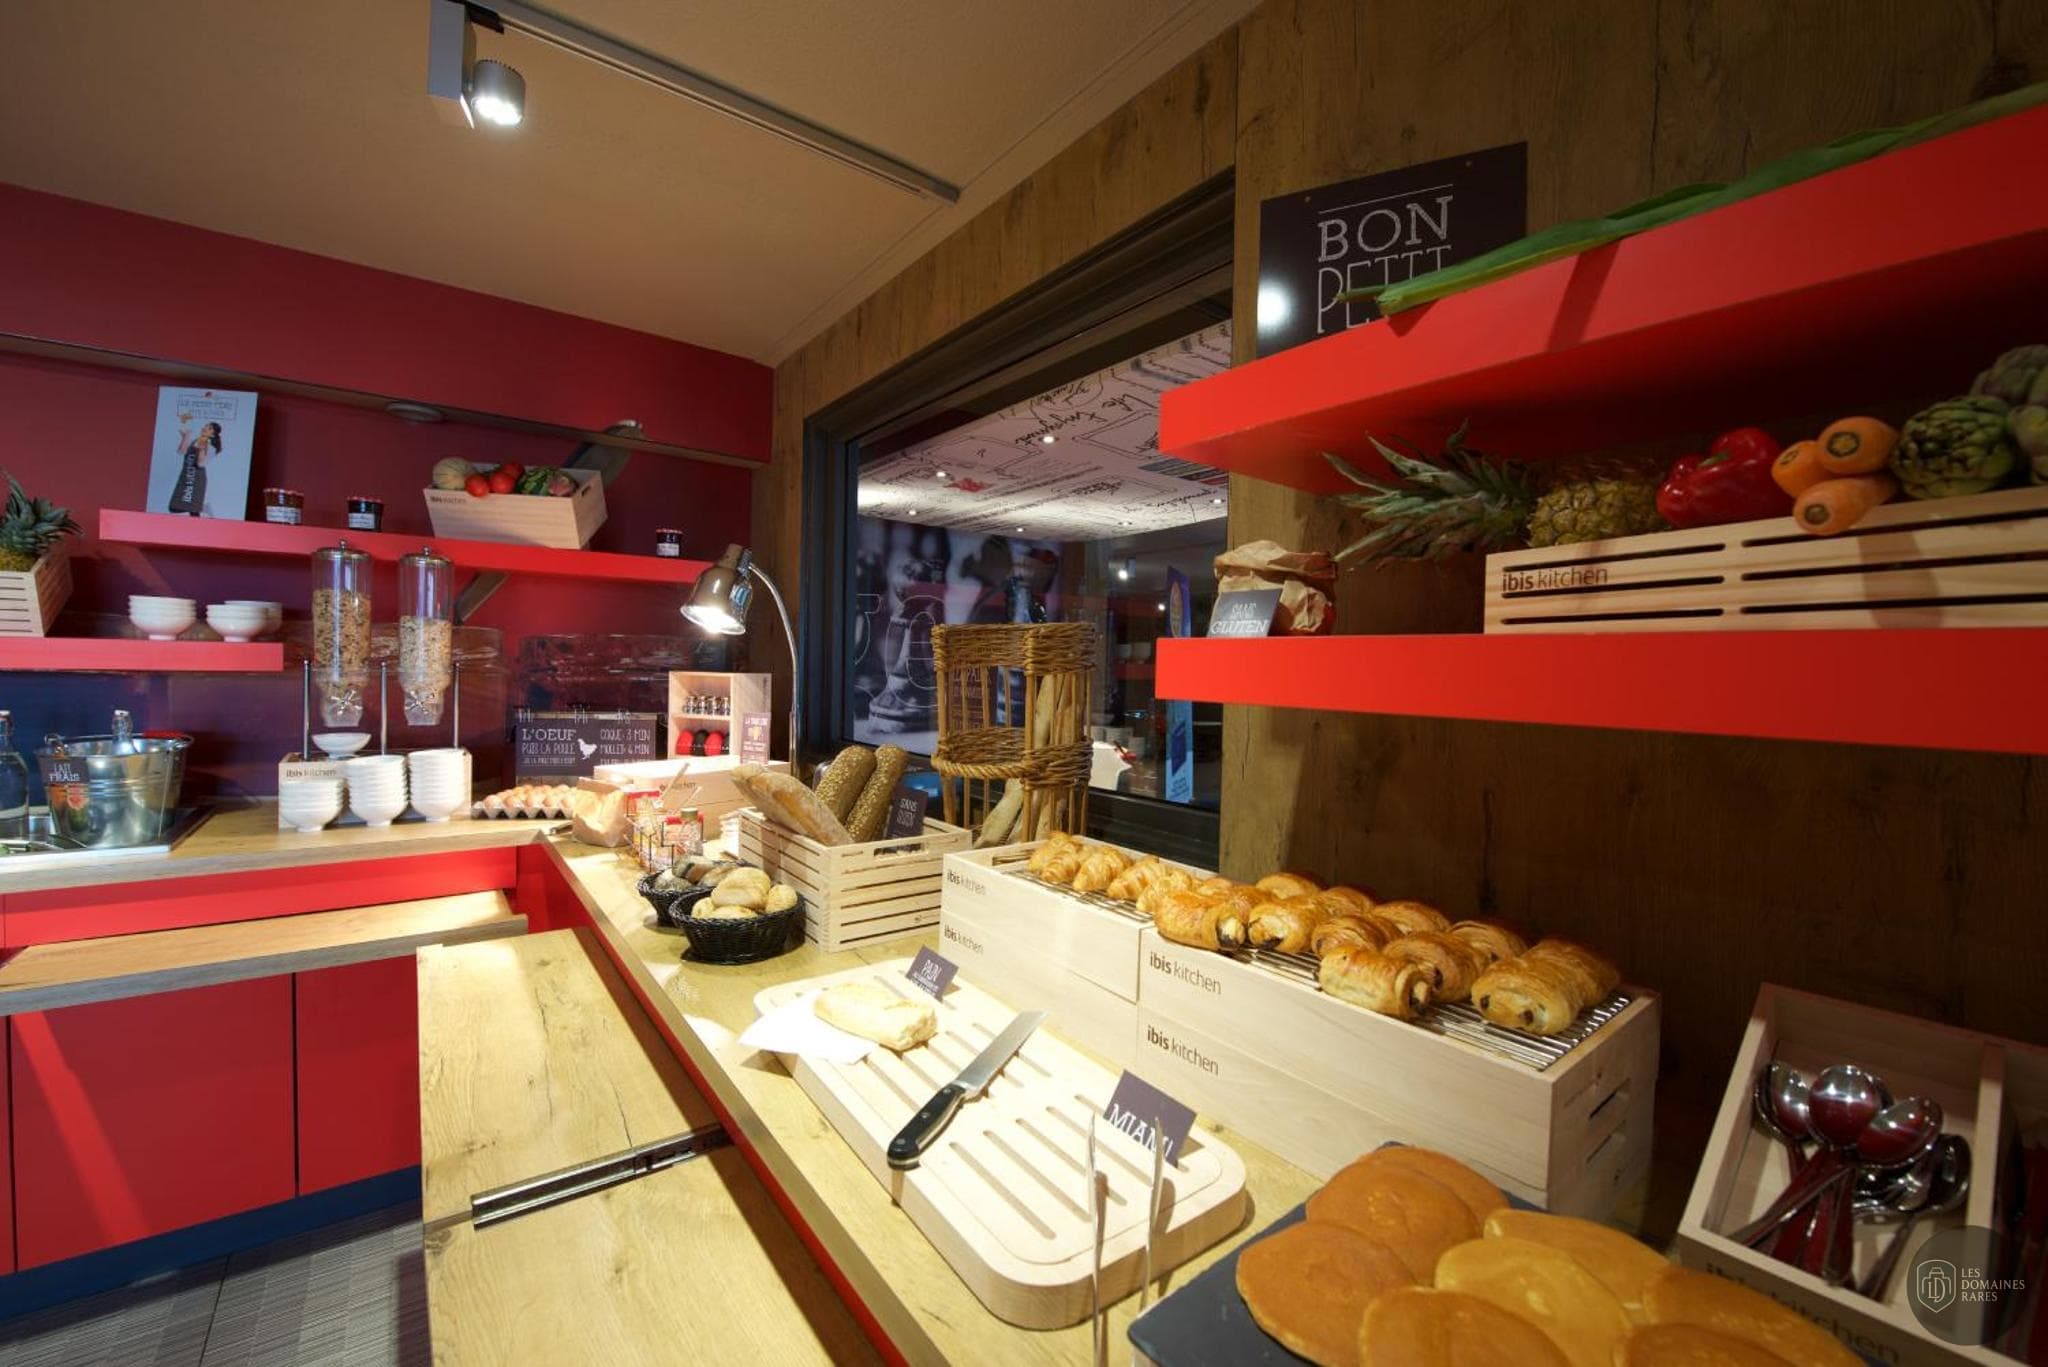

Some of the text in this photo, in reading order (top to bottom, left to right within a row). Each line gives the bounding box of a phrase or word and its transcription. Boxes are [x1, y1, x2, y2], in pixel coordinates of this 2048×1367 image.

[1317, 195, 1453, 263] BON
[1502, 567, 1608, 592] ibis kitchen
[1210, 619, 1269, 634] GLUTEN
[521, 728, 577, 741] L'OEUF
[634, 728, 651, 741] MIN
[541, 742, 551, 754] LA
[553, 742, 576, 755] POULE
[634, 743, 650, 755] MIN
[54, 763, 71, 773] LAIT
[286, 768, 337, 777] ibis kitchen
[48, 772, 81, 782] FRAIS
[947, 869, 961, 885] ibis
[944, 925, 985, 955] ibis kitchen
[1150, 951, 1222, 995] ibis kitchen
[1147, 1025, 1219, 1076] ibis kitchen
